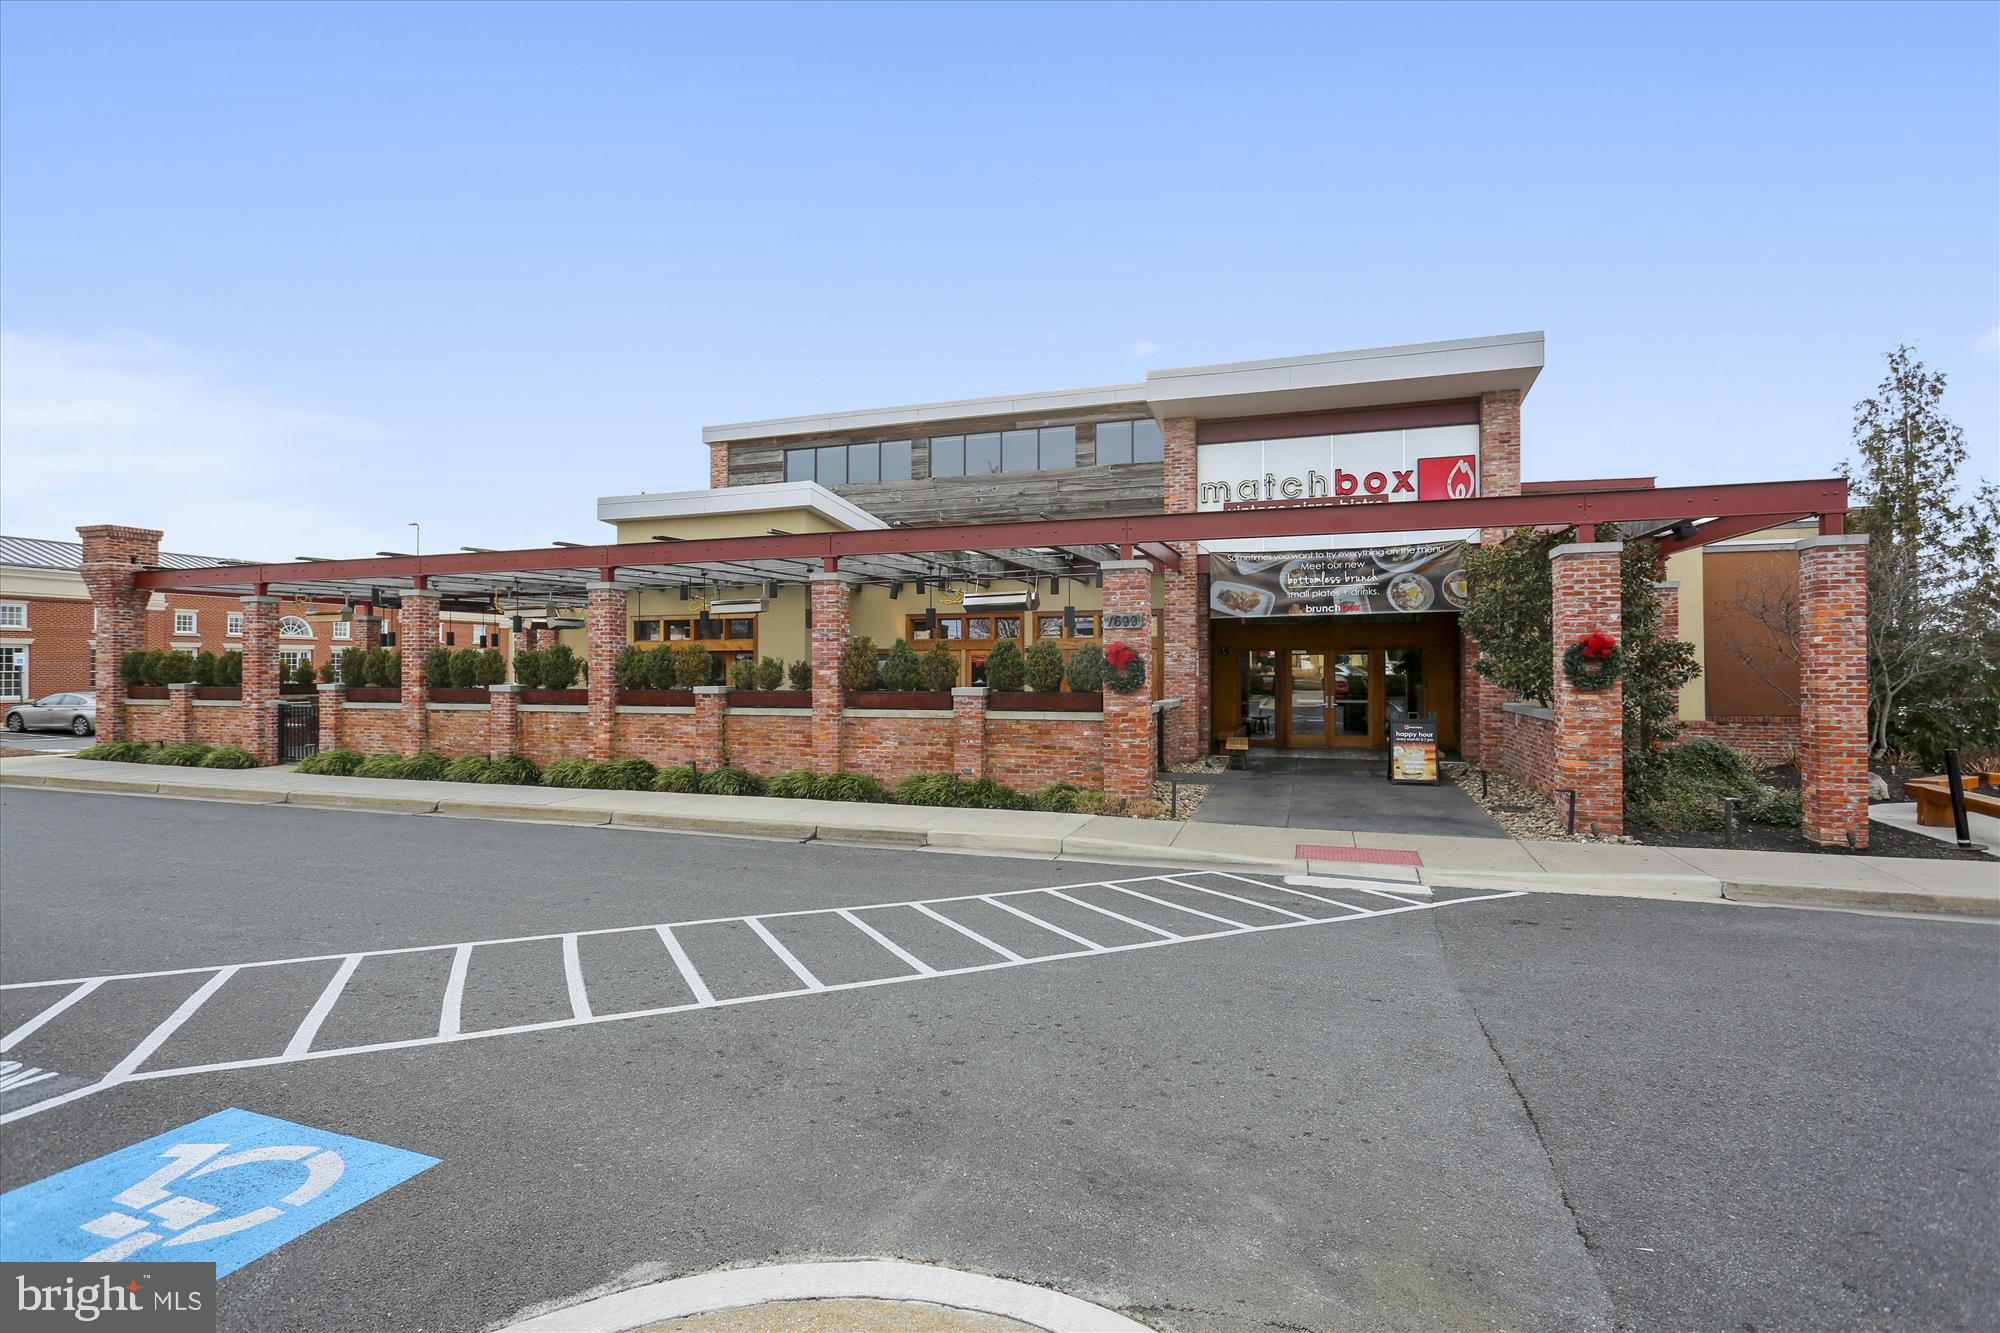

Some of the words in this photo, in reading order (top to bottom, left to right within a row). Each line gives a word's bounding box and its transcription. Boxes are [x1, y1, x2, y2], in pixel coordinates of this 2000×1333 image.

[1201, 469, 1415, 503] matchbox
[1227, 551, 1272, 562] Sometimes
[1273, 553, 1289, 562] you
[1290, 551, 1314, 560] want
[1315, 551, 1325, 559] to
[1326, 550, 1337, 560] try
[1338, 548, 1385, 559] everything
[1386, 547, 1399, 555] on
[1400, 546, 1416, 555] the
[1417, 544, 1447, 554] menu.
[1300, 562, 1325, 570] Meet
[1327, 562, 1343, 570] our
[1344, 561, 1366, 569] new
[1287, 571, 1341, 586] bottomless
[1344, 569, 1378, 583] brunch
[1286, 589, 1310, 599] small
[1311, 589, 1341, 599] plates
[1350, 587, 1380, 597] drinks.
